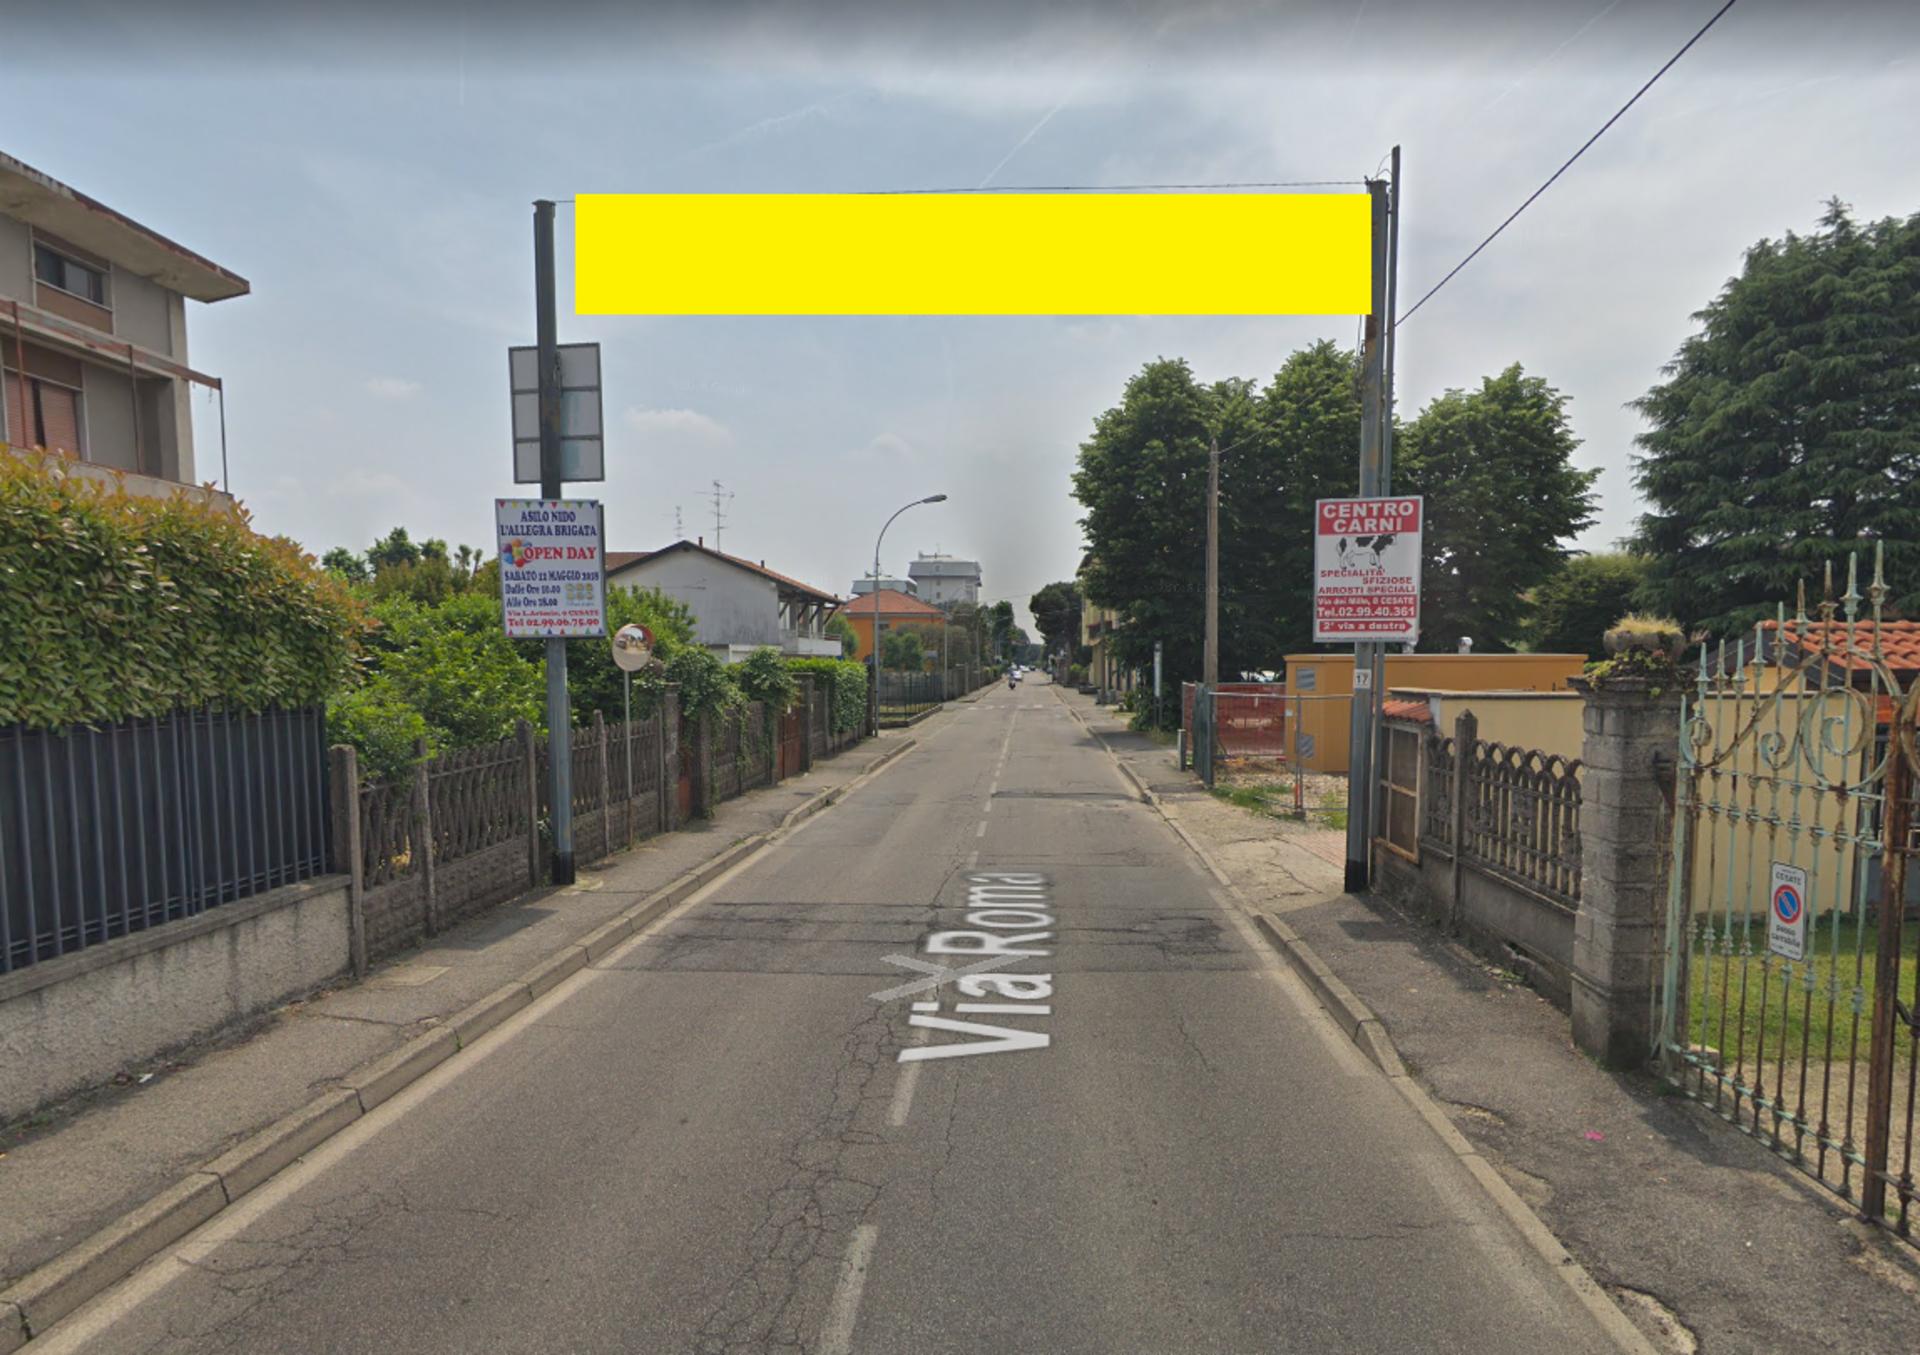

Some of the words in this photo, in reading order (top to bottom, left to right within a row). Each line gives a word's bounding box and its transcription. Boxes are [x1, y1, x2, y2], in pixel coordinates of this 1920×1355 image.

[1323, 502, 1414, 518] CENTRO
[521, 511, 549, 522] ASILO
[552, 511, 577, 522] NIDO
[1333, 517, 1403, 533] CARNI
[501, 525, 552, 536] L'ALLEGRA
[554, 525, 597, 536] BRIGATA
[524, 546, 563, 560] OPEN
[566, 546, 597, 560] DAY
[505, 570, 537, 581] SABATO
[548, 570, 580, 581] MAGGIO
[1362, 577, 1413, 585] SFIZIOSE
[527, 584, 540, 594] Ore
[1319, 586, 1364, 595] ARROSTI
[1366, 585, 1416, 594] SPECIALI
[523, 597, 537, 606] Ore
[1380, 596, 1415, 605] CESATE
[508, 618, 524, 627] Tel
[1337, 622, 1355, 630] via
[1358, 622, 1366, 630] a
[1356, 672, 1370, 687] 17
